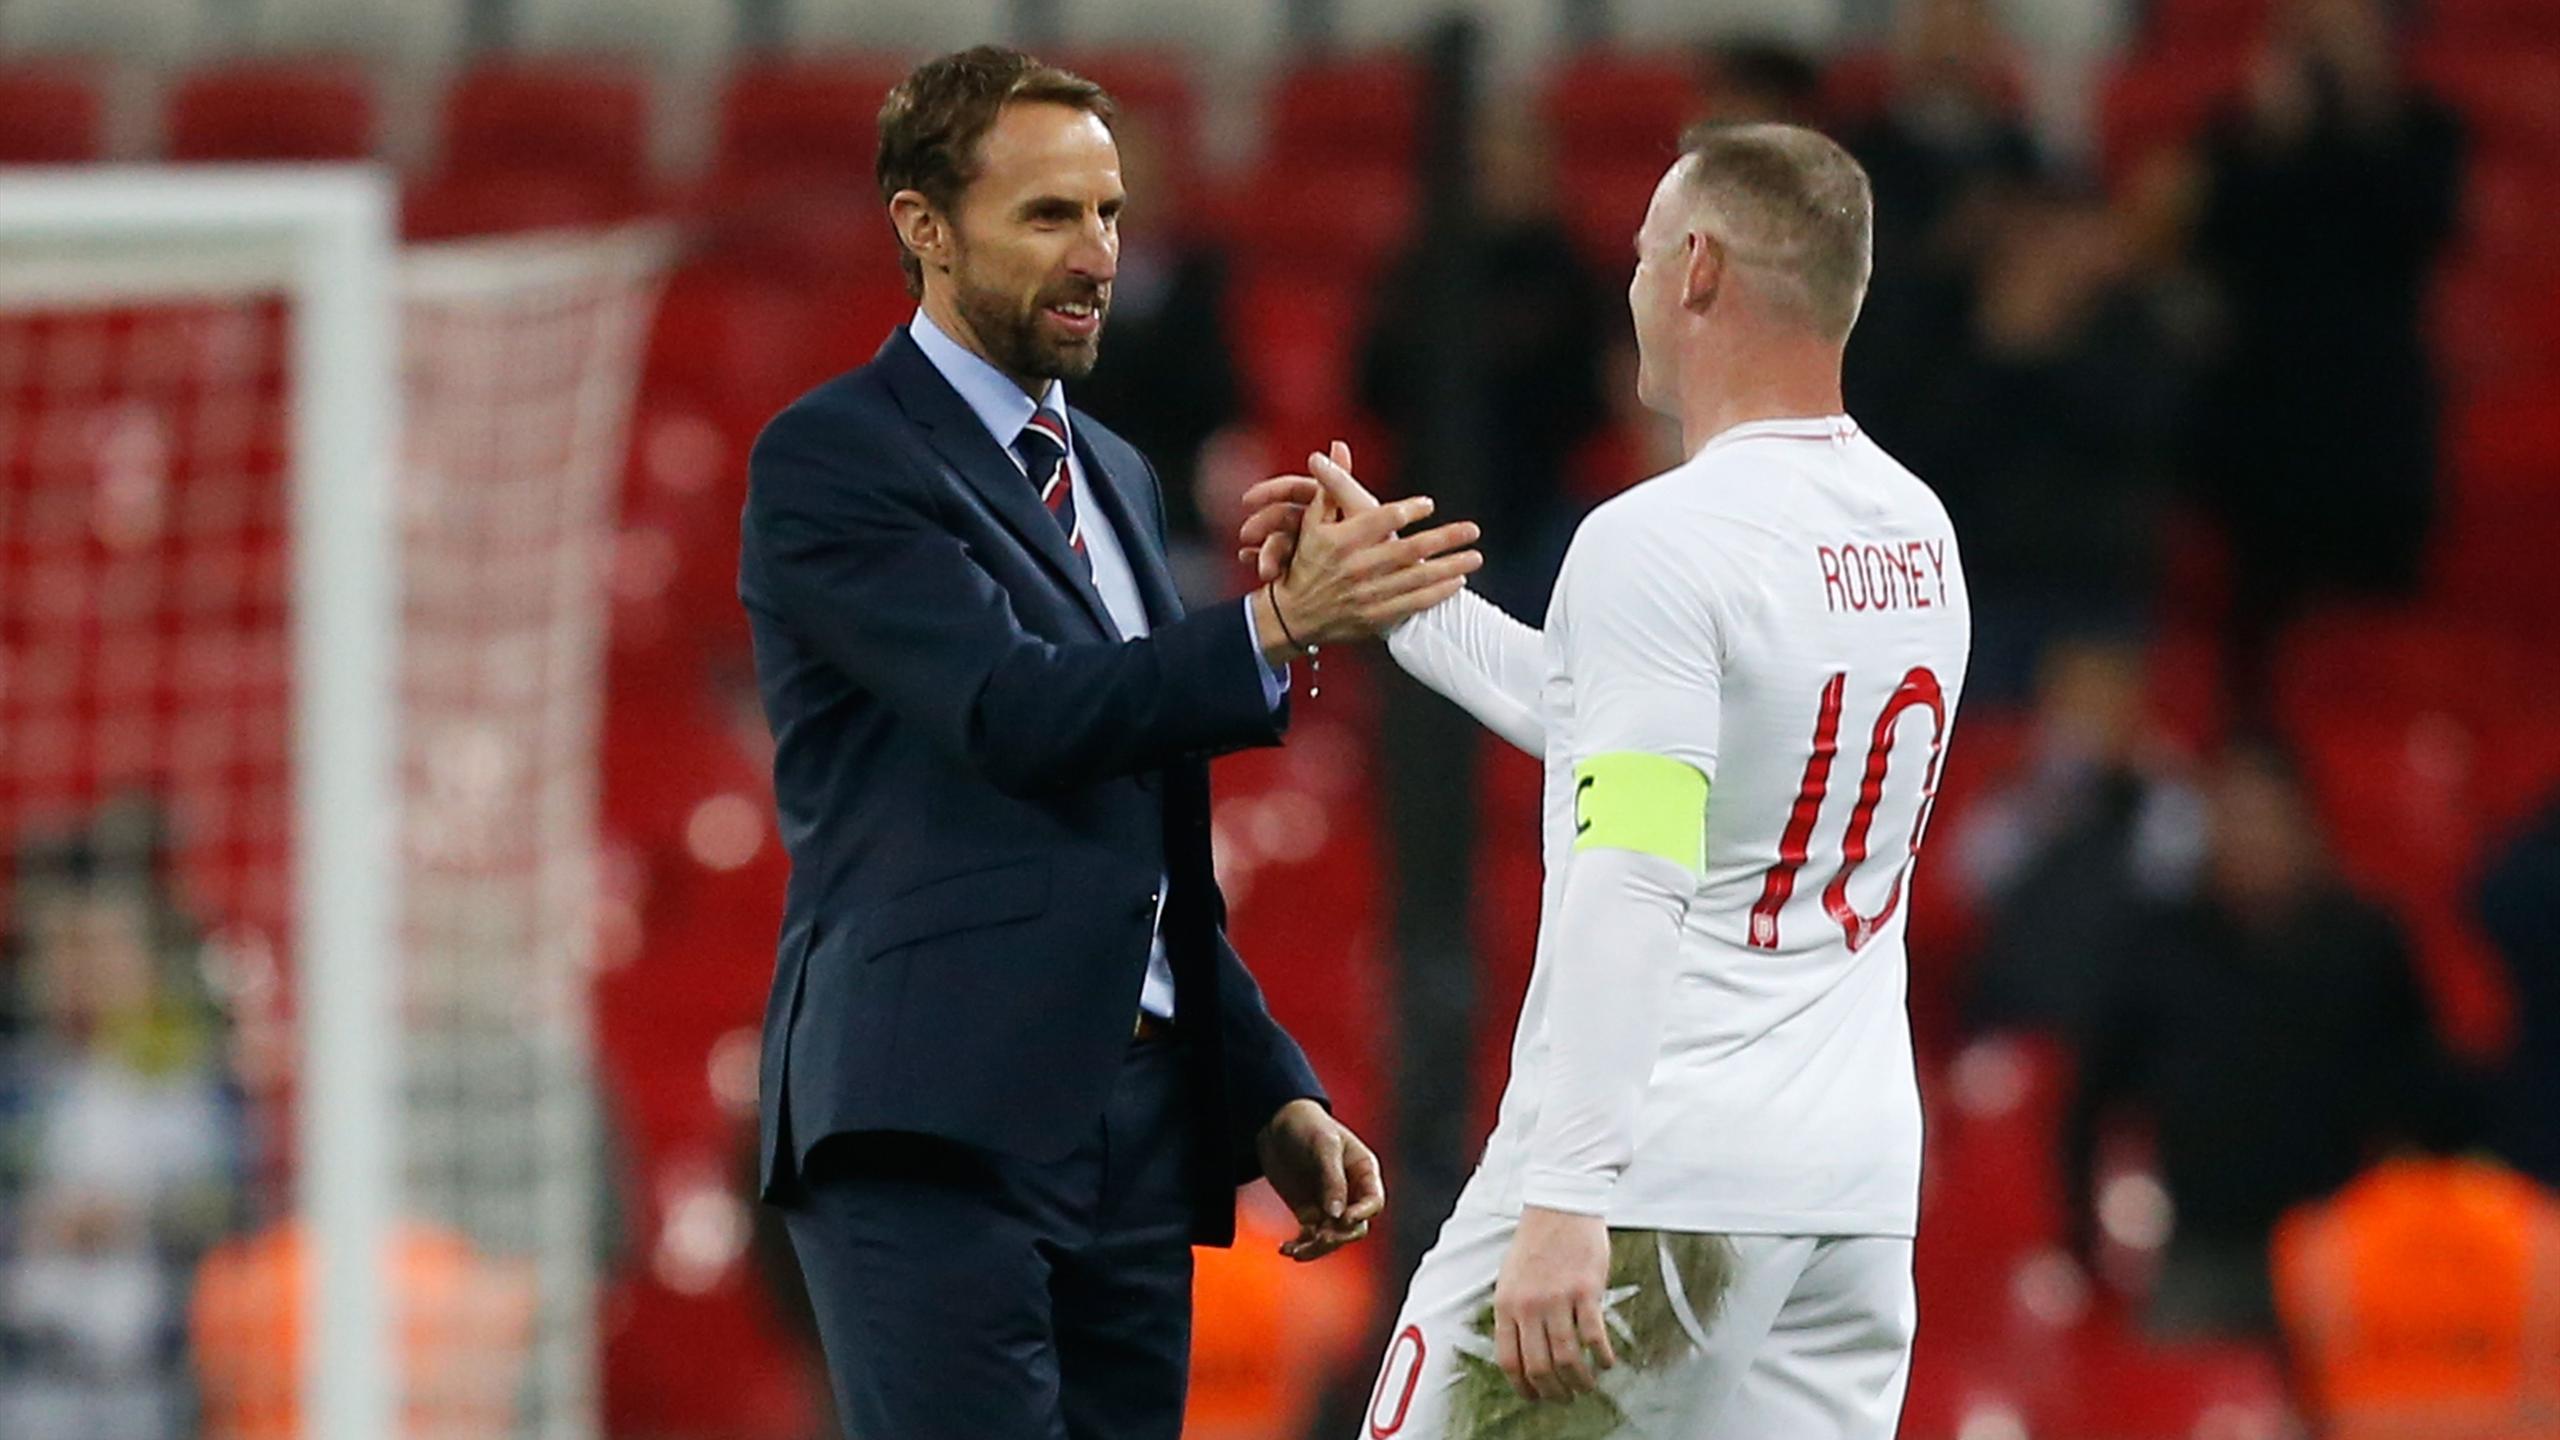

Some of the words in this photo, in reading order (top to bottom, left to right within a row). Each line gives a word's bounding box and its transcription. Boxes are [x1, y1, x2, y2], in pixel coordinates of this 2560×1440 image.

[1817, 539, 1948, 612] ROONEY
[1574, 775, 1595, 836] C
[1748, 666, 1945, 953] 10
